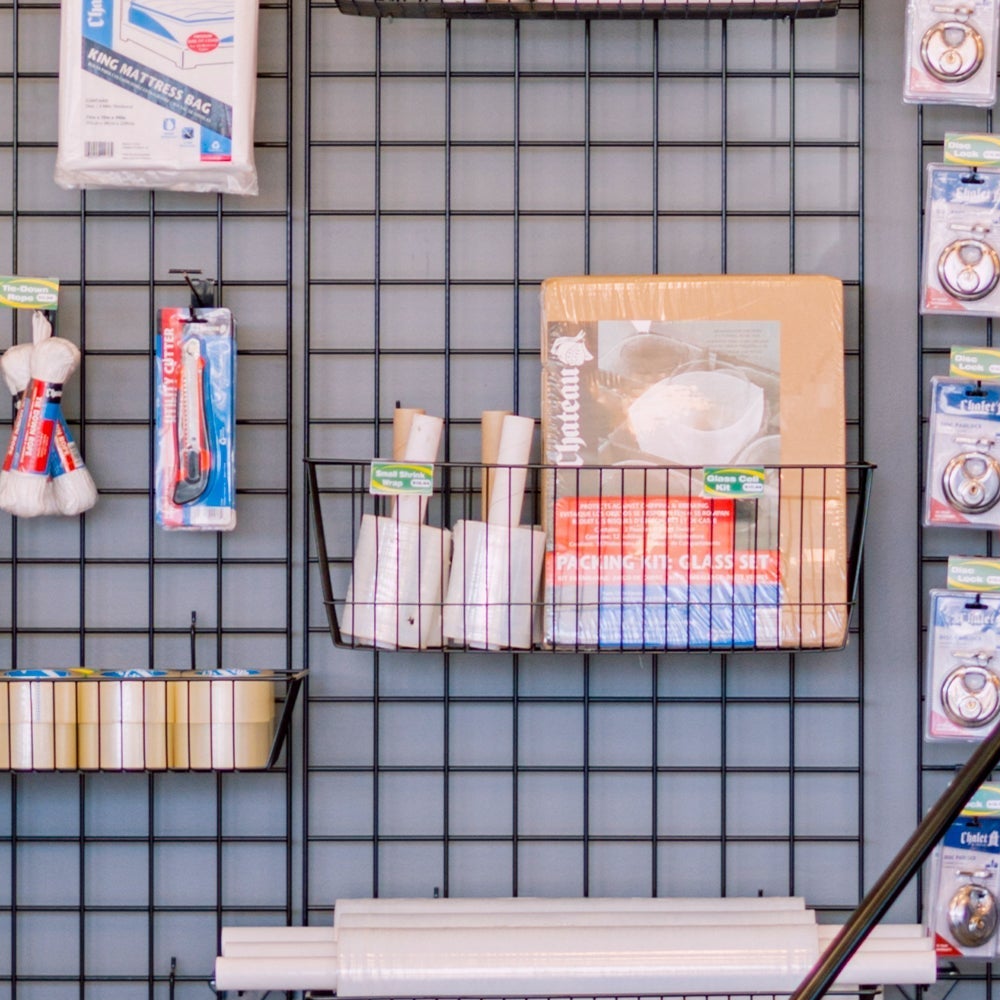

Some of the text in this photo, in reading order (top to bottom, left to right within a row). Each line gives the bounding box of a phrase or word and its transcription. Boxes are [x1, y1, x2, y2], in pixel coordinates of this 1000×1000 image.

[88, 48, 212, 114] KING MATTRESS BAG
[948, 142, 971, 150] Disc
[953, 150, 978, 158] Lock
[3, 285, 49, 293] Tie-Down
[8, 294, 34, 302] Rope
[955, 354, 978, 363] Disc
[959, 363, 984, 371] Lock
[162, 327, 177, 423] UTILITY CUTTER
[960, 399, 996, 413] Chalet
[555, 368, 587, 465] Chateau
[707, 475, 736, 483] Glass
[382, 479, 403, 488] Wrap
[556, 553, 770, 570] PACKING KIT: GLASS SET
[952, 566, 975, 574] Disc
[958, 575, 982, 583] Lock
[960, 831, 988, 846] Chalet
